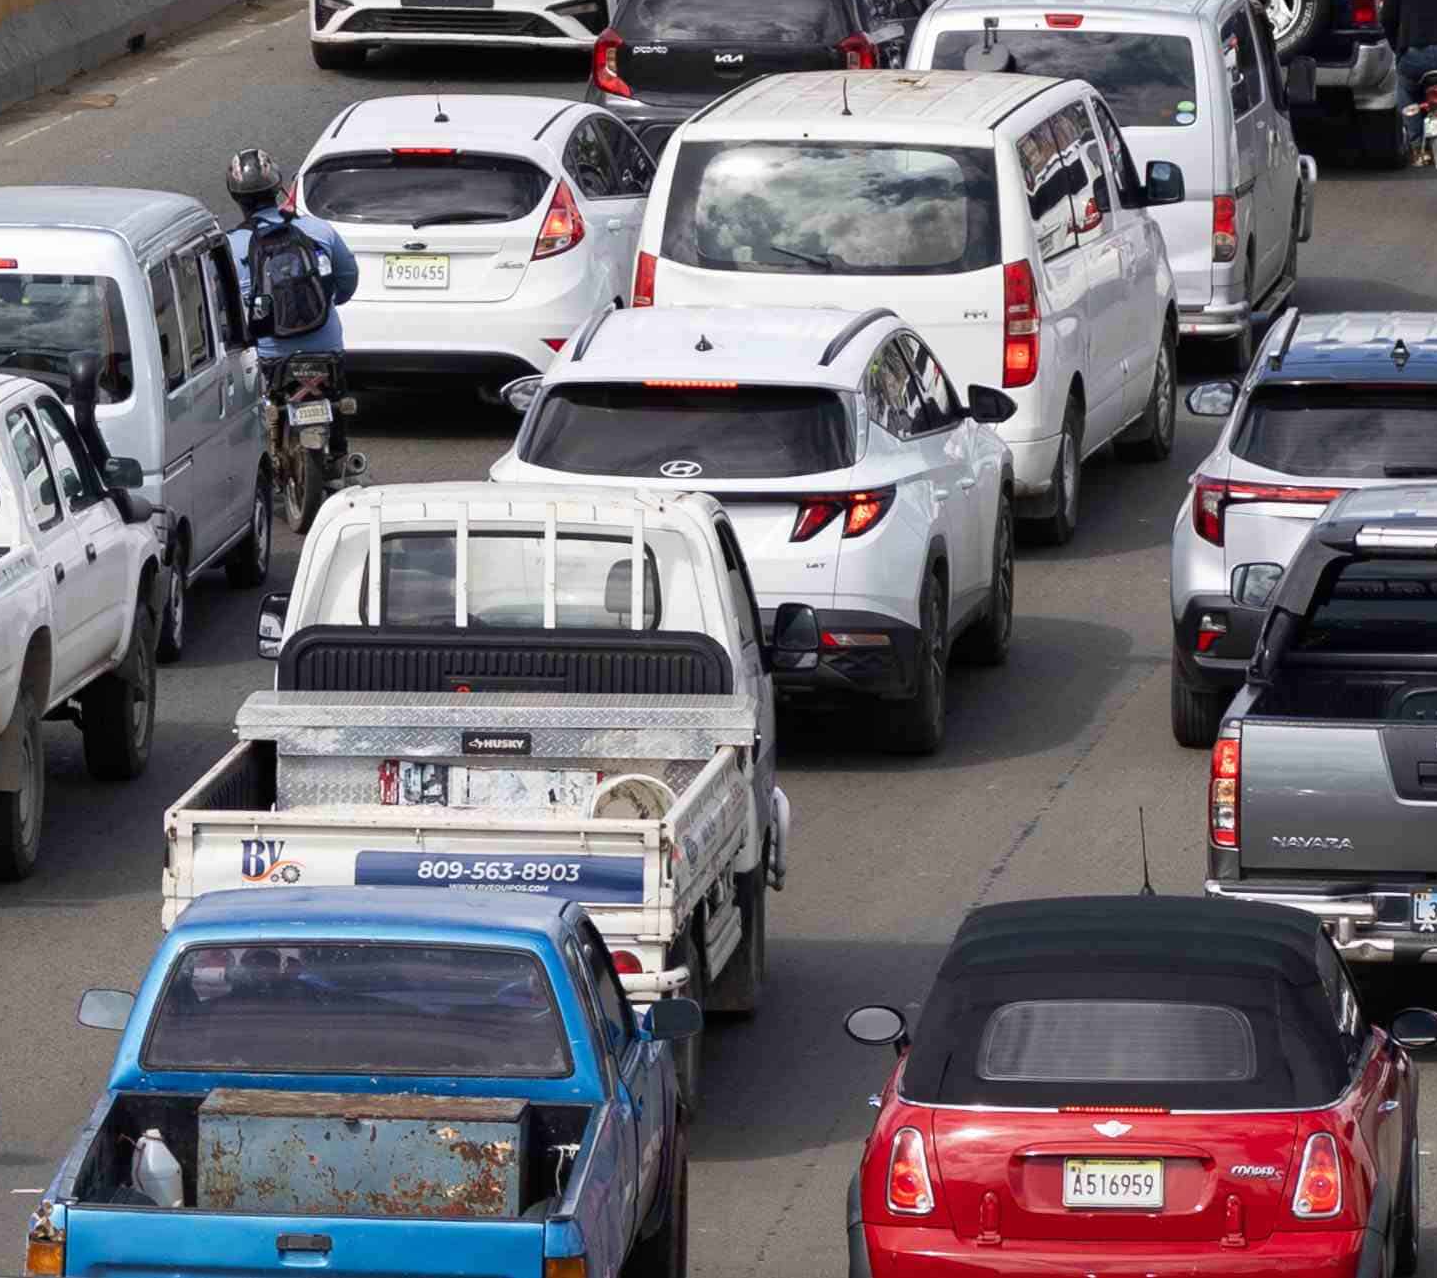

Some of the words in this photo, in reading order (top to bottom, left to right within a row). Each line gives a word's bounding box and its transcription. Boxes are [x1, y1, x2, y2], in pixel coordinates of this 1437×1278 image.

[484, 739, 525, 750] HUSKY
[1272, 835, 1356, 850] NAVARA
[241, 839, 285, 877] BV
[417, 859, 581, 884] 809-563-8903
[1071, 1174, 1155, 1197] A516959
